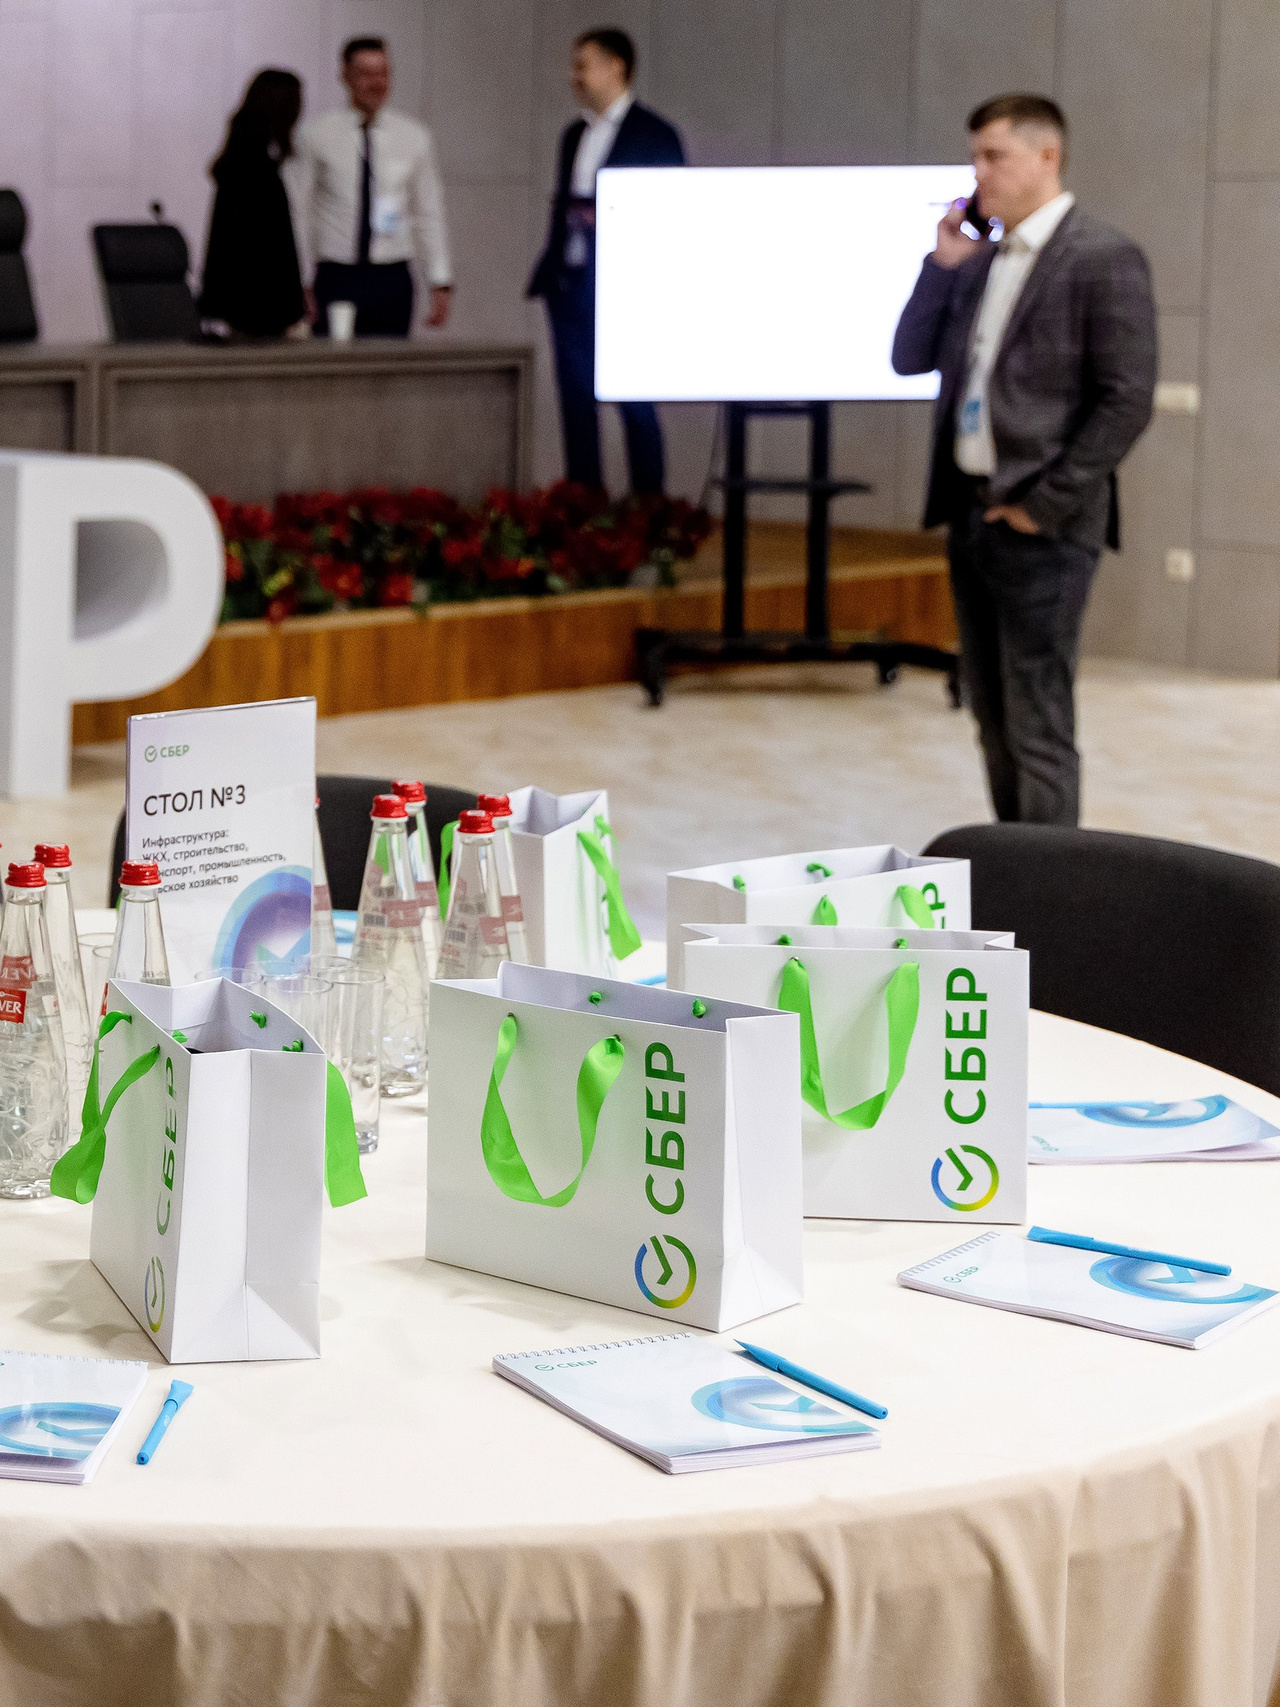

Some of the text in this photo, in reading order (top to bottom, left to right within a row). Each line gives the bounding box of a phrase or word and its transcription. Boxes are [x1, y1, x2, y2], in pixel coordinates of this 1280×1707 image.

[160, 744, 190, 759] СБЕР
[143, 784, 246, 816] СТОЛ №3
[142, 829, 229, 849] Инфраструктура:
[173, 842, 248, 861] строительство,
[158, 852, 286, 878] нспорт, промышленность,
[157, 873, 239, 894] ьское хозяйство
[944, 967, 987, 1124] СБЕР
[644, 1041, 686, 1215] СБЕР
[156, 1056, 177, 1236] СБЕР
[556, 1359, 598, 1369] СБЕР
